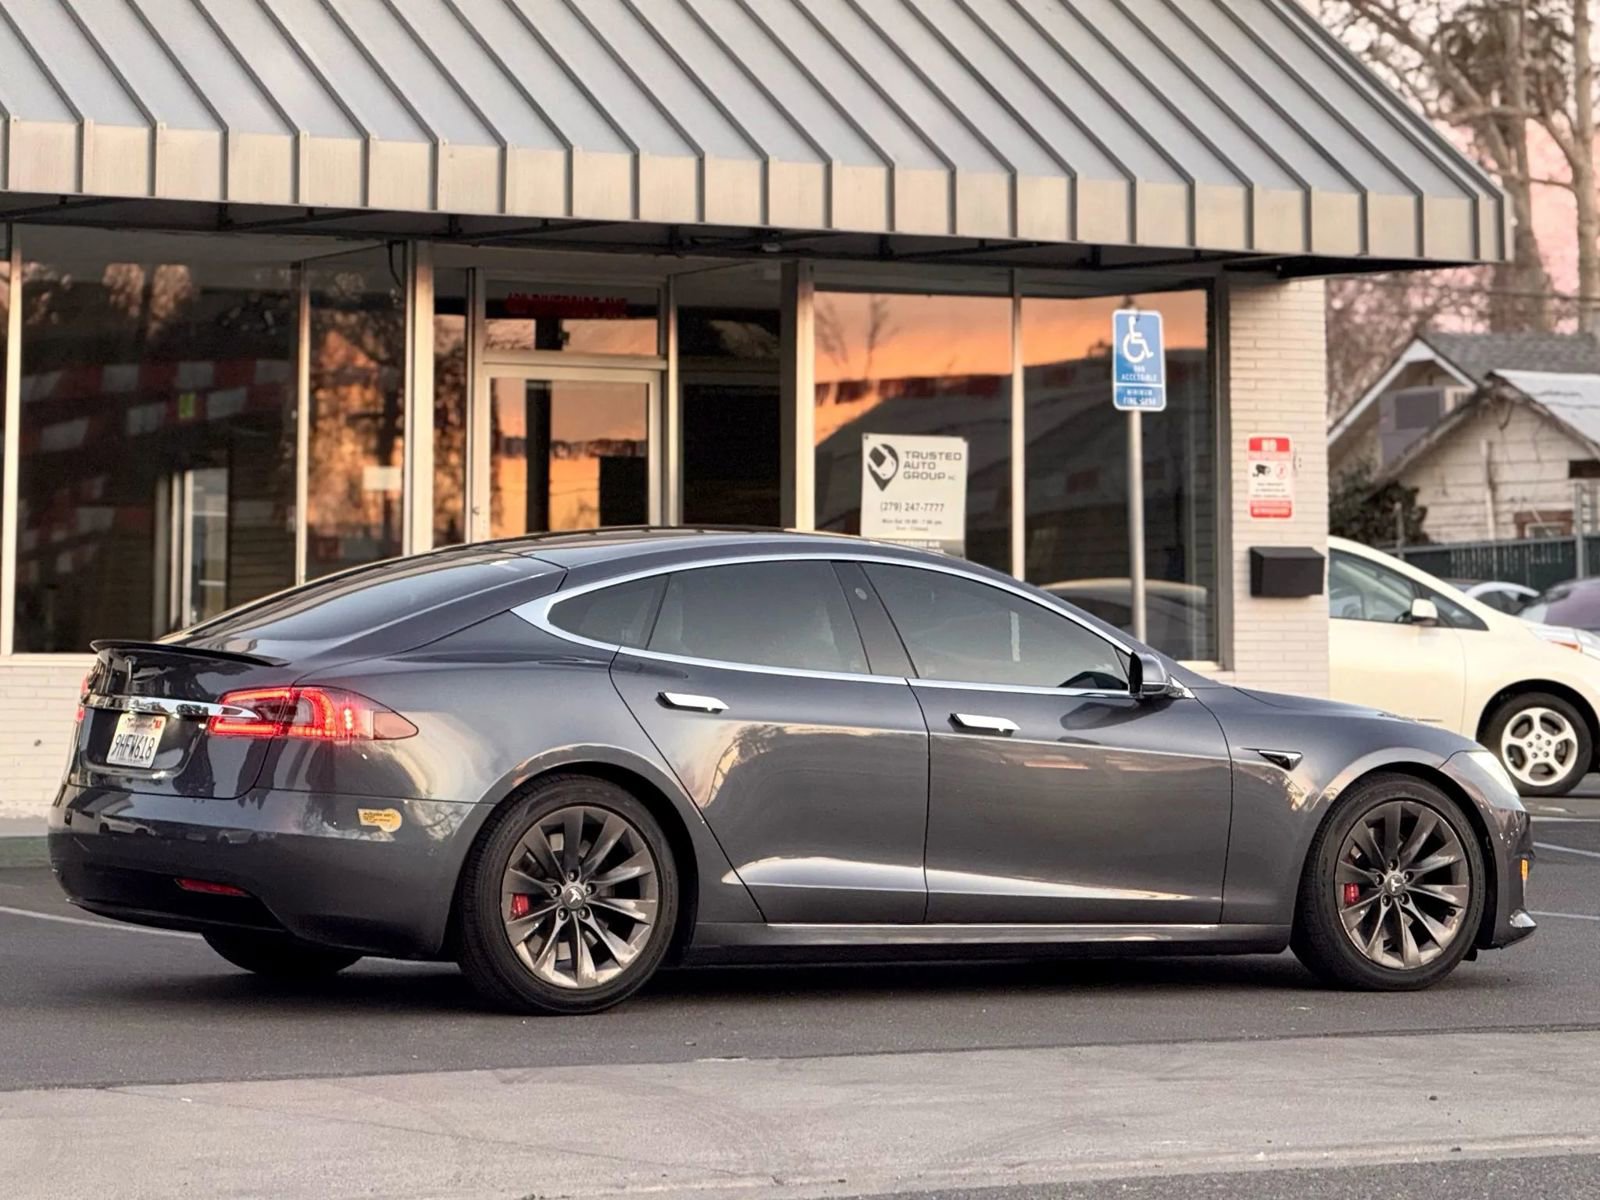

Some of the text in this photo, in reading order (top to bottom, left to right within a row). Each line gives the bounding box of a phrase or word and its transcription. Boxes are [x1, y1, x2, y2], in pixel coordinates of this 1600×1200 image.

[904, 451, 962, 461] TRUSTED
[903, 461, 936, 470] AUTO
[903, 471, 946, 481] GROUP
[880, 502, 944, 512] (279) 247-7777
[111, 734, 156, 760] 9HFW618
